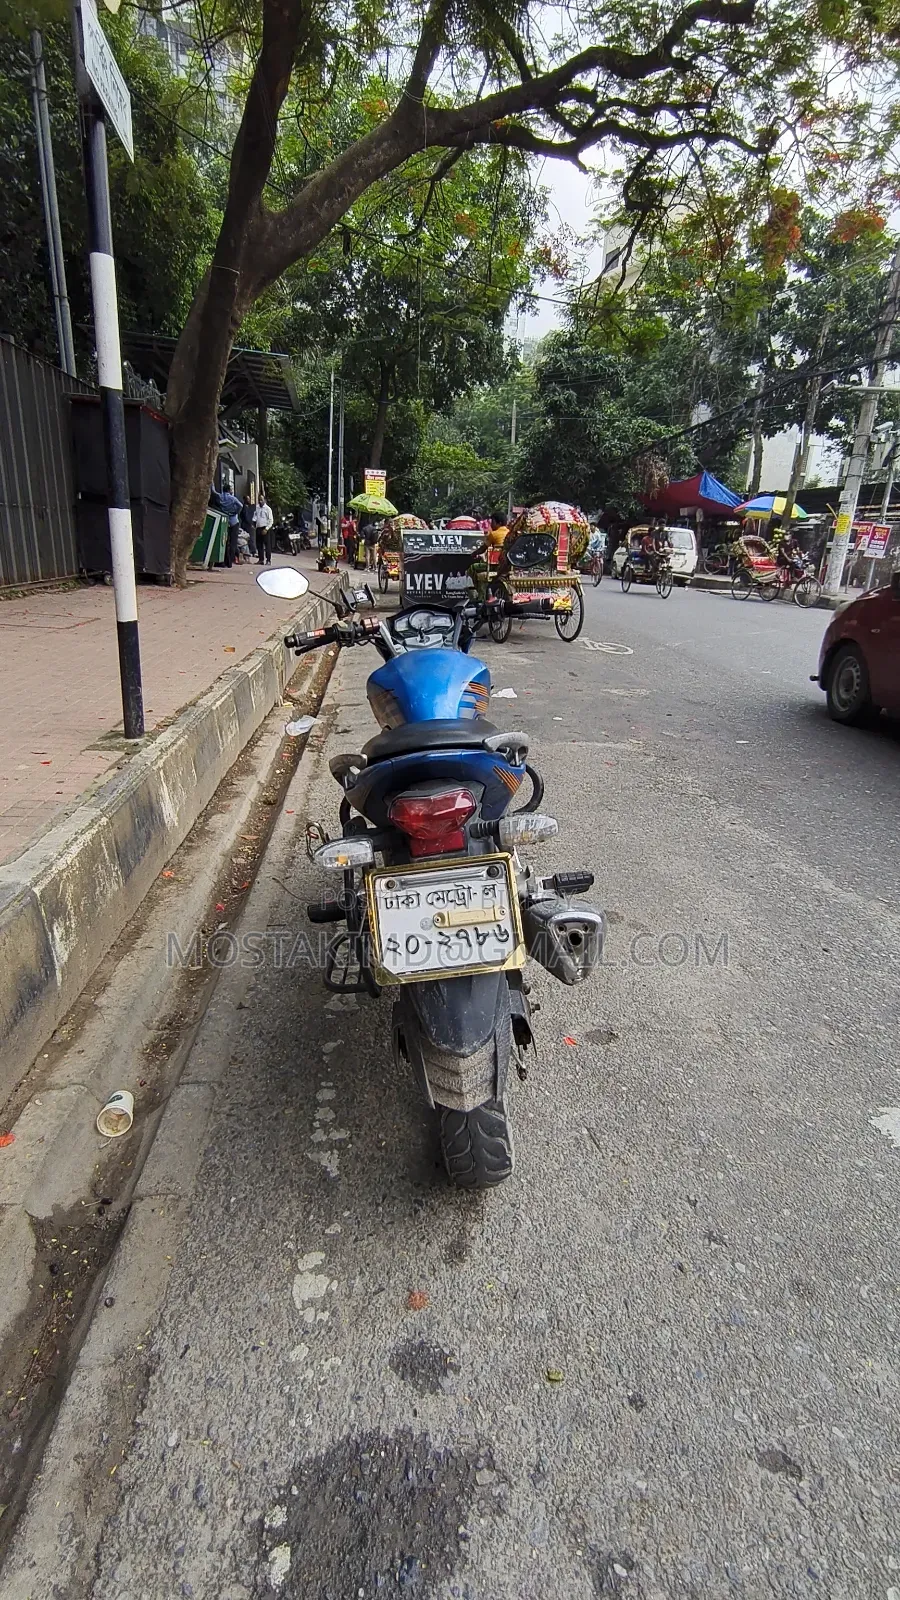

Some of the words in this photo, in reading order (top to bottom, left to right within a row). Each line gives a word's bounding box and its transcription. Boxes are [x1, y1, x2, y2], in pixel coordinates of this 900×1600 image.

[432, 535, 463, 545] LYEV
[406, 573, 444, 590] LYEV
[384, 892, 421, 910] ঢাকা
